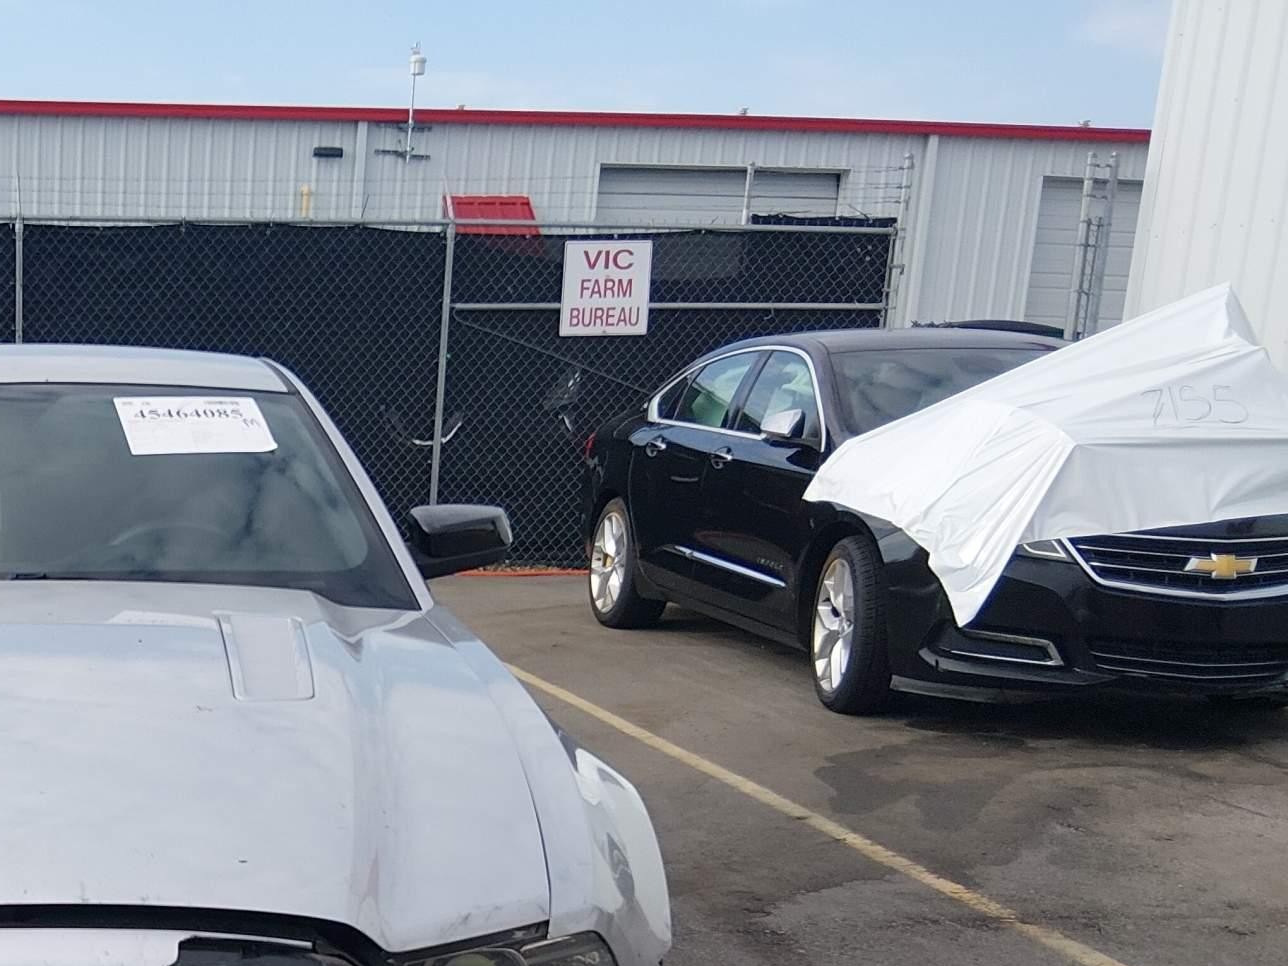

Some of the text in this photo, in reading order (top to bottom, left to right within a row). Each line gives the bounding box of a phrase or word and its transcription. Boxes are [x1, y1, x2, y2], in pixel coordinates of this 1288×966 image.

[583, 249, 634, 270] VIC
[579, 278, 633, 299] FARM
[569, 306, 640, 327] BUREAU
[134, 408, 243, 420] 45464085
